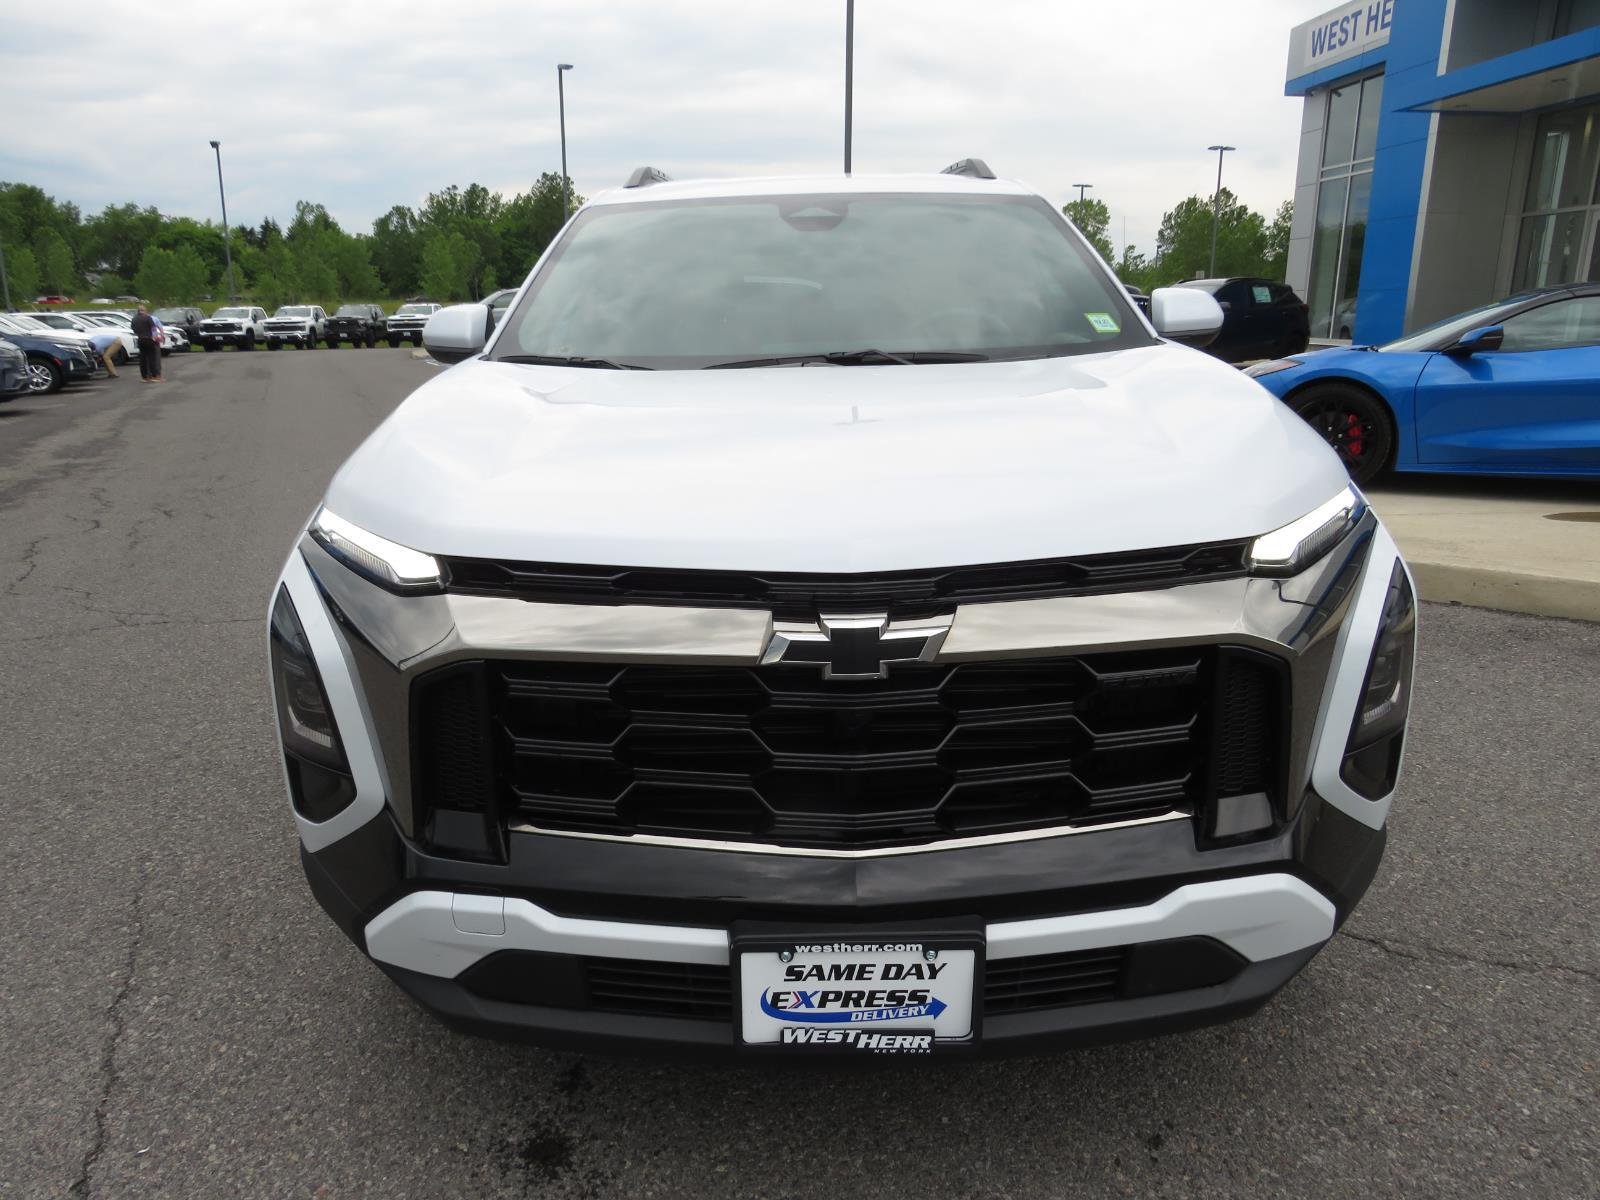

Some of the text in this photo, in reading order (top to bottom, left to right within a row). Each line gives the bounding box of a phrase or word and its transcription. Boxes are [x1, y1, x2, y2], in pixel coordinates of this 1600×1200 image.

[1311, 9, 1362, 58] WEST
[795, 943, 923, 952] westherr.com
[784, 962, 948, 982] SAME DAY
[770, 989, 930, 1010] EXPRESS
[850, 1004, 930, 1022] DELIVERY
